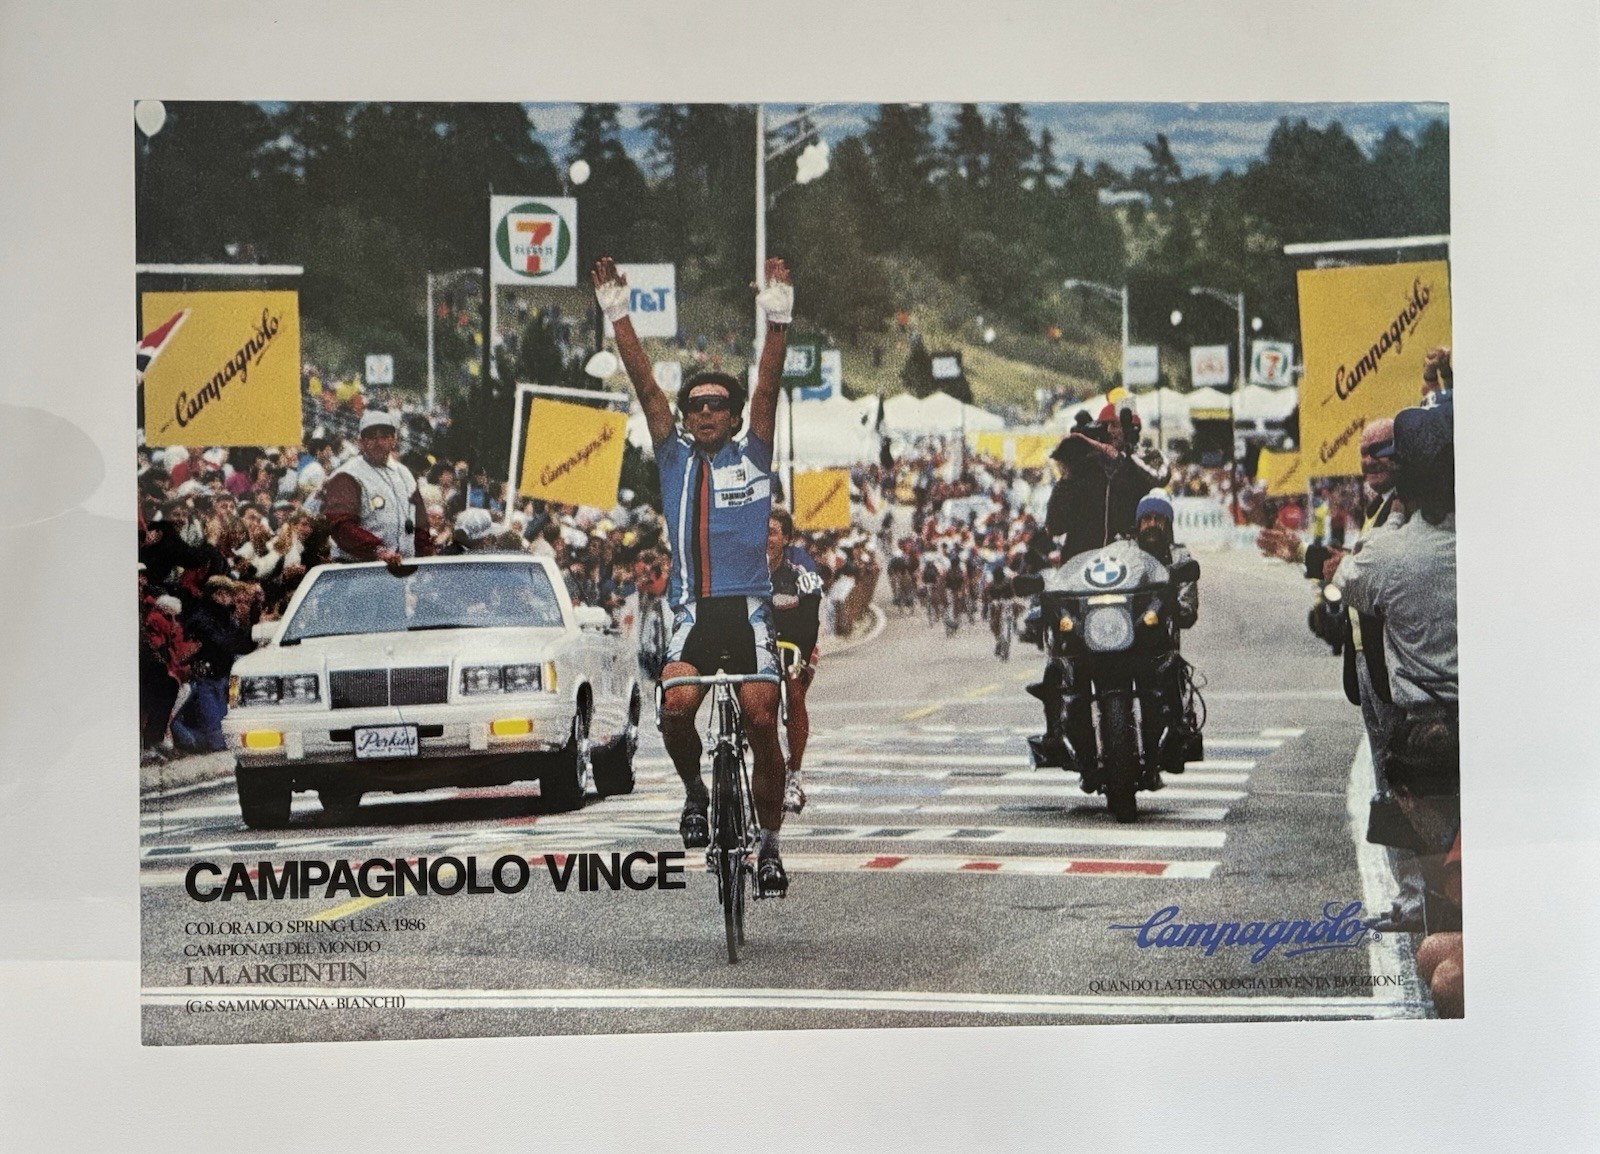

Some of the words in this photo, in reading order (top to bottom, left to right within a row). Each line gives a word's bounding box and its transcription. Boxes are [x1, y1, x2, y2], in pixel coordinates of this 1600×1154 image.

[515, 220, 553, 273] 7
[628, 288, 670, 312] T&T
[1321, 276, 1431, 406] Campagnolo
[161, 308, 282, 432] Campagnolo
[358, 729, 416, 751] Perkins
[185, 854, 530, 903] CAMPAGNOLO
[543, 851, 687, 893] VINCE
[185, 920, 283, 935] COLORADO
[286, 919, 347, 934] SPRING
[350, 919, 391, 932] U.S.A.
[394, 918, 426, 931] 1986
[1108, 901, 1370, 964] Campagnolo
[184, 943, 282, 957] CAMPIONATI
[284, 942, 316, 955] DEL
[319, 940, 381, 954] MONDO
[202, 965, 230, 985] M.
[236, 962, 368, 984] ARGENTIN
[1089, 979, 1152, 993] QUANDO
[1155, 979, 1173, 991] LA
[1174, 977, 1267, 990] TECNOLOGIA
[1270, 976, 1331, 989] DIVENTA
[1333, 975, 1406, 987] EMOZIONE
[186, 999, 216, 1014] (G.S.
[217, 997, 328, 1012] SAMMONTANA
